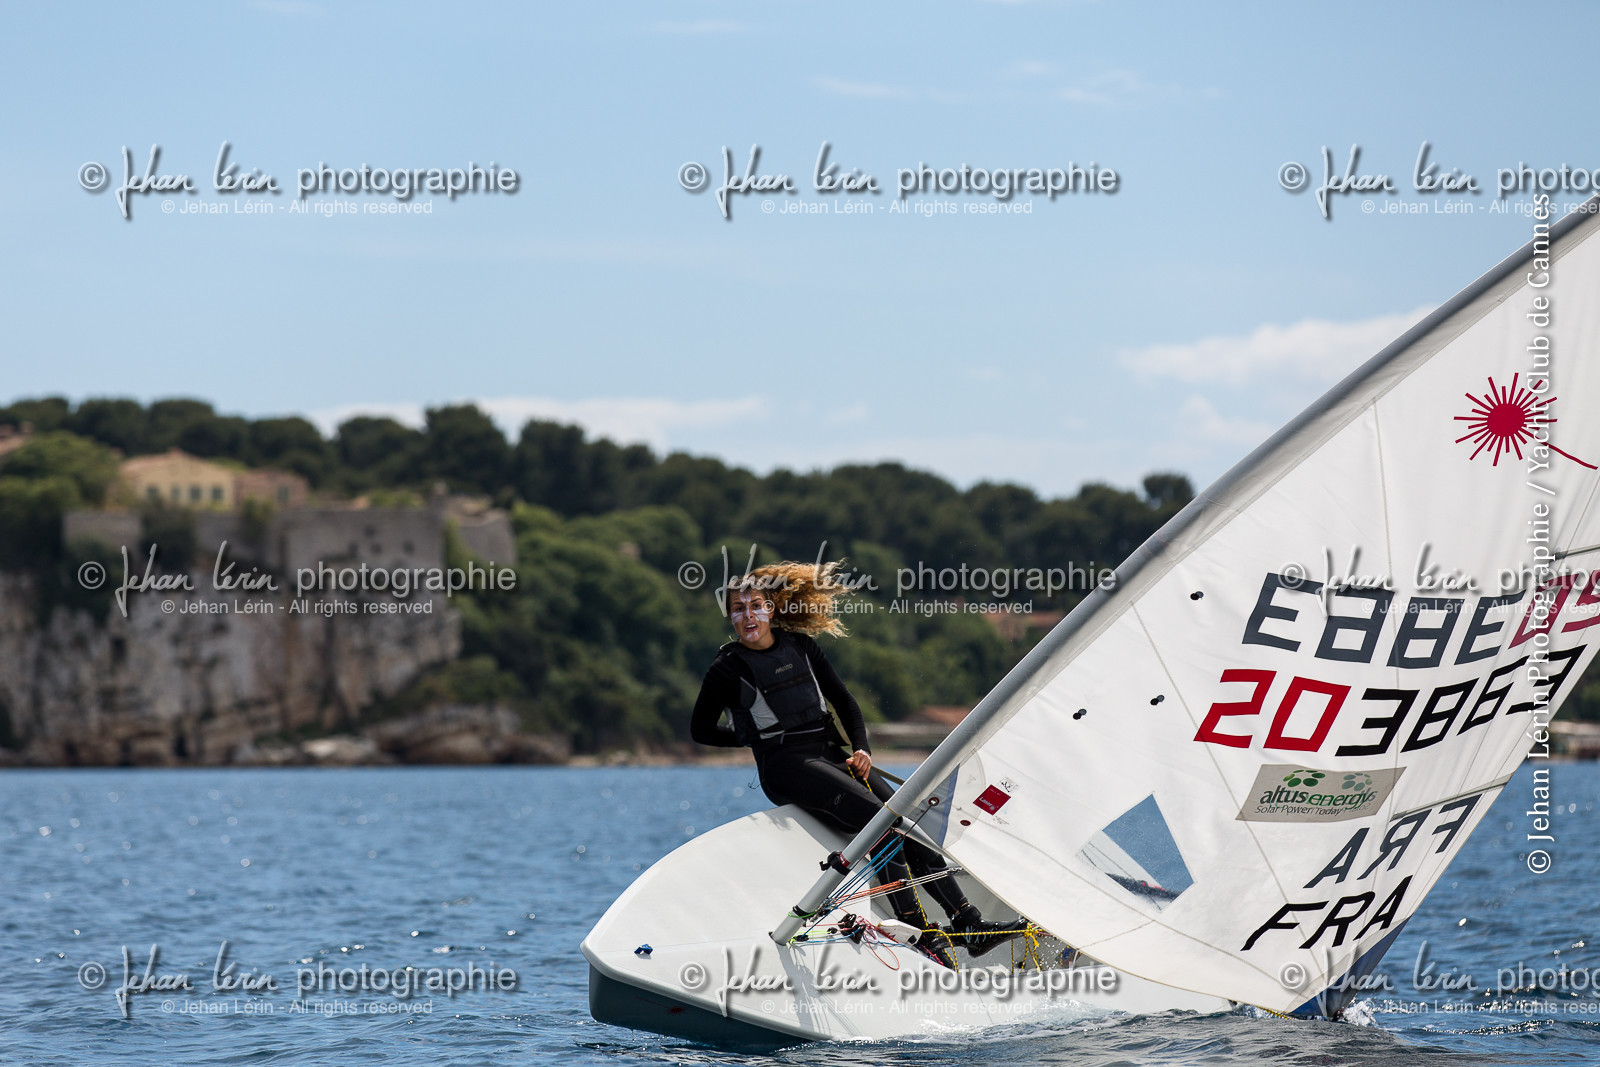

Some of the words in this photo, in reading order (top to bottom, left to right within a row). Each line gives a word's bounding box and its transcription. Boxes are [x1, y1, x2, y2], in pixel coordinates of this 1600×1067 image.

[1255, 805, 1279, 814] Solar
[1281, 804, 1311, 815] Power
[1316, 807, 1343, 816] Today
[1240, 875, 1413, 951] FRA
